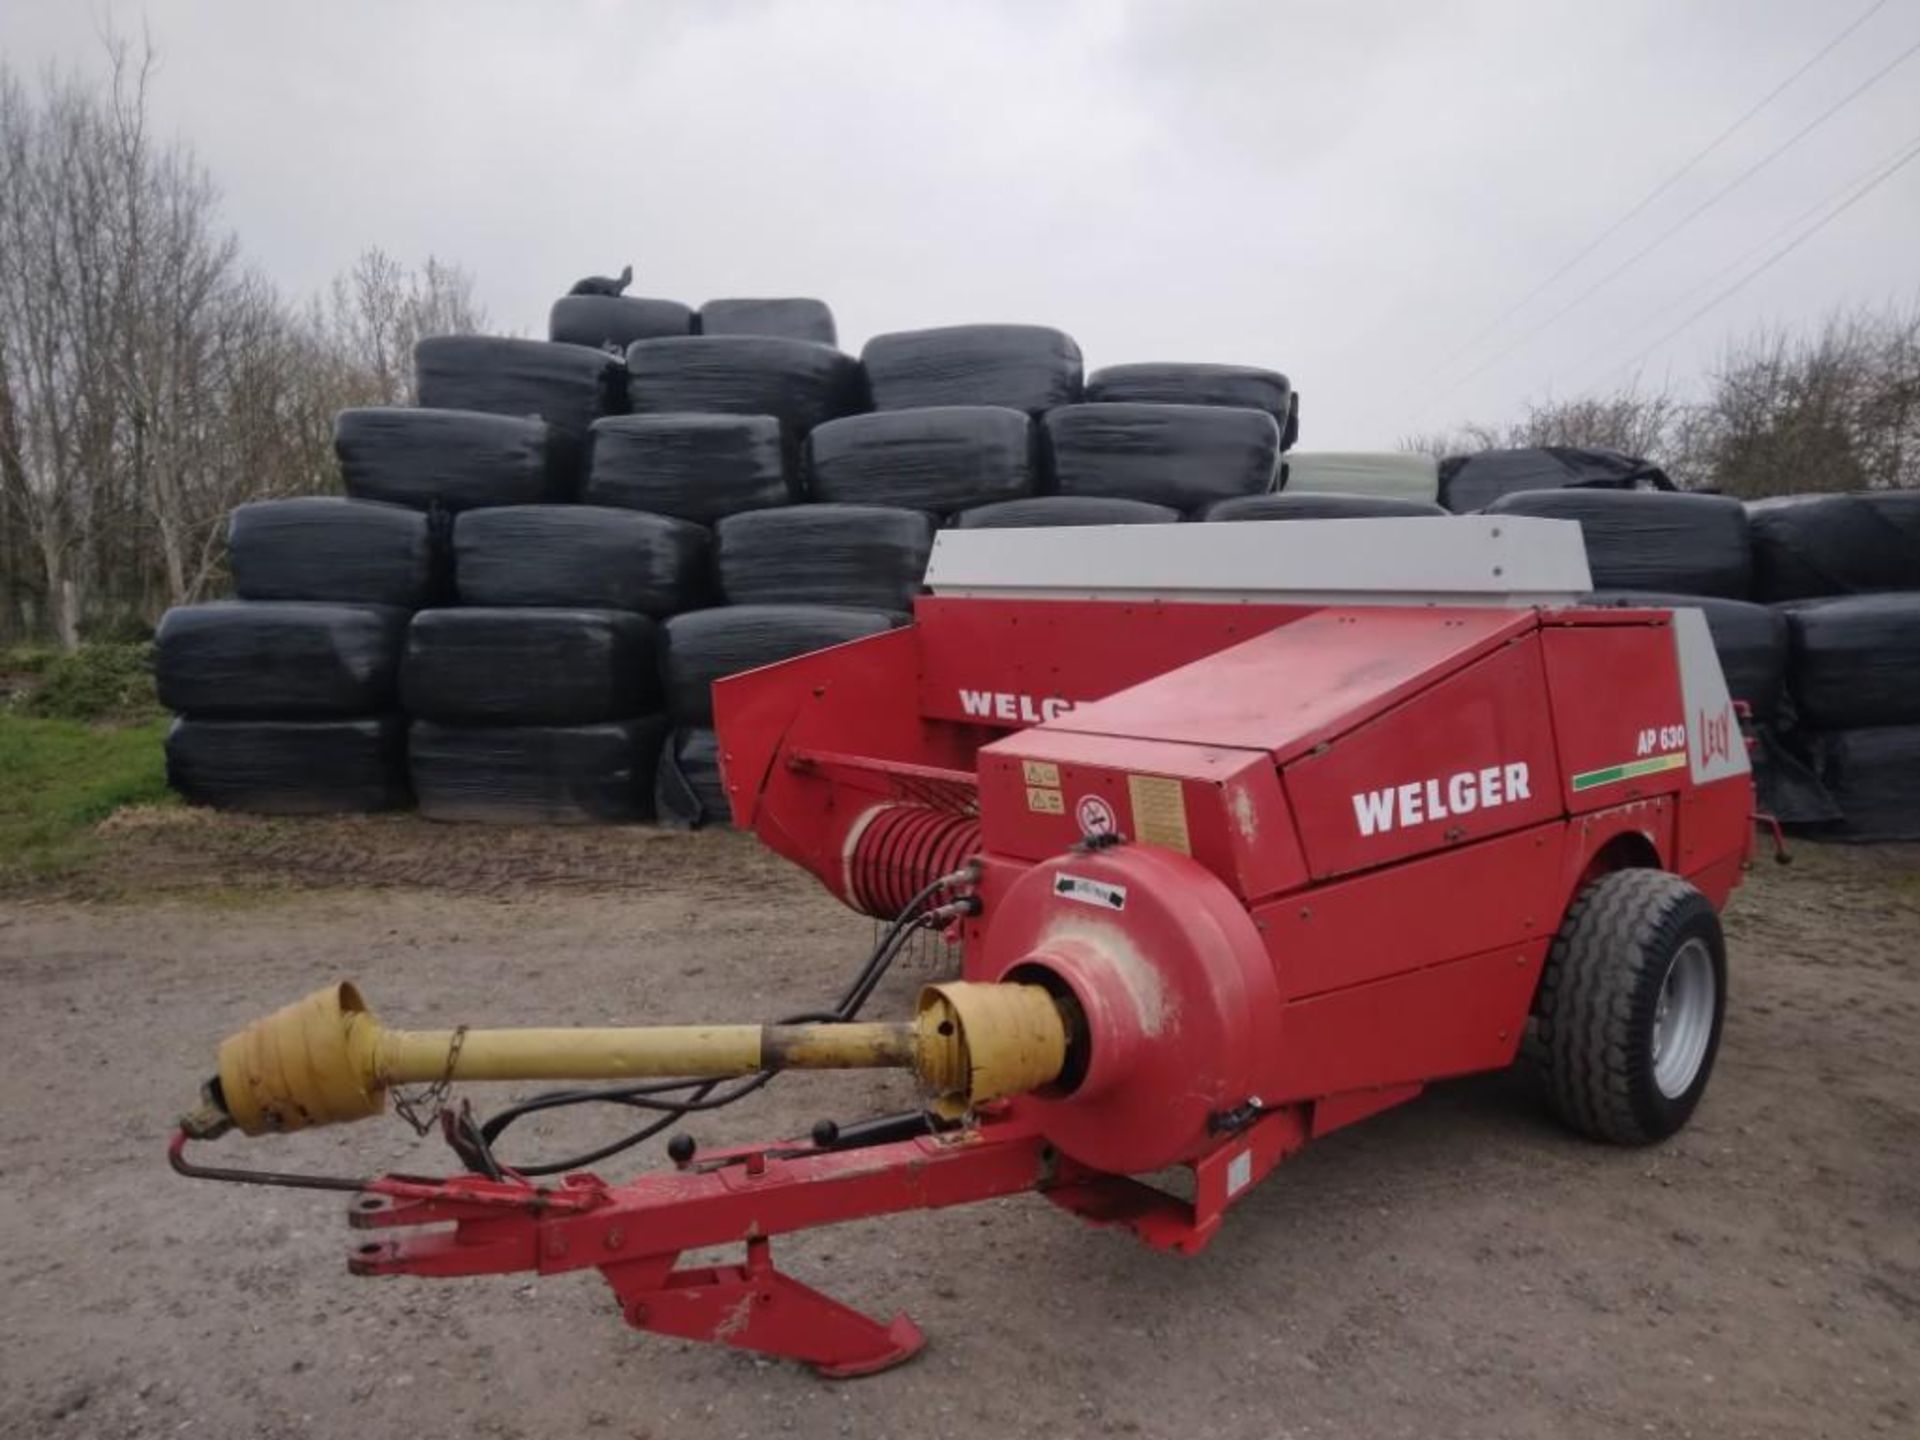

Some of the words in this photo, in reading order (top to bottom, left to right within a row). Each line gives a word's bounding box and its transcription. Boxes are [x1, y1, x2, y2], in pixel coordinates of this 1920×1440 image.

[958, 689, 1088, 722] WELG
[1637, 729, 1657, 757] AP
[1660, 724, 1685, 750] 630
[1699, 706, 1730, 768] LELY
[1352, 761, 1531, 837] WELGER
